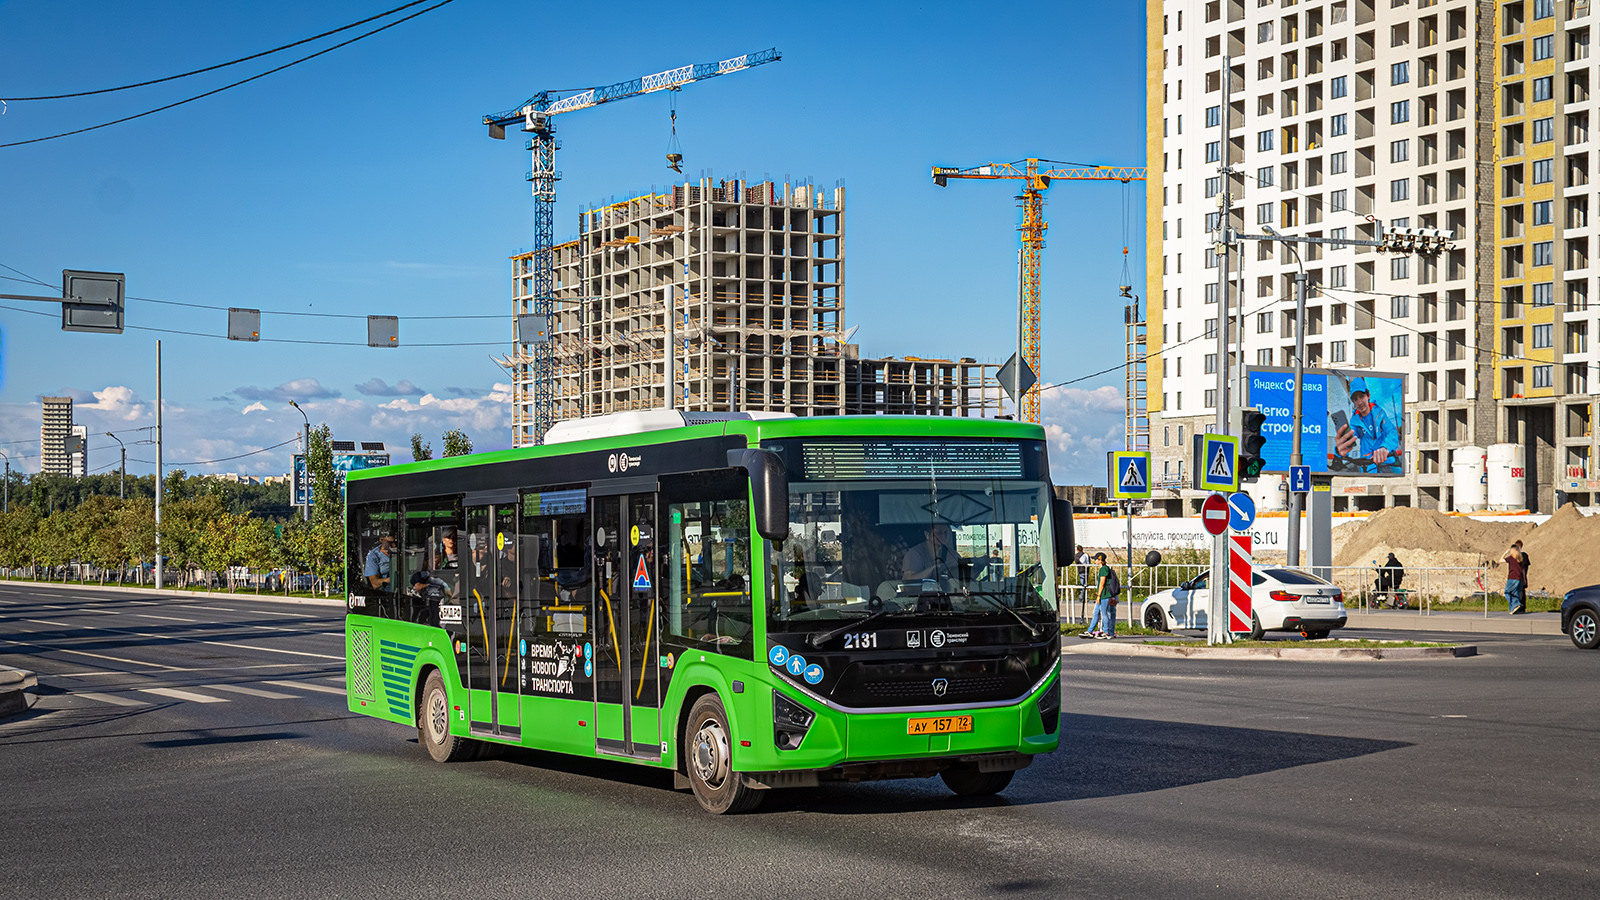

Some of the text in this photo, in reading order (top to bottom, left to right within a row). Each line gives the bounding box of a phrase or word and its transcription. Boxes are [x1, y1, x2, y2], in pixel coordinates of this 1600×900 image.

[1254, 378, 1322, 392] Яндекс авка
[1261, 422, 1321, 435] строиься
[1122, 530, 1205, 542] Пжалуйста, проходите
[843, 632, 877, 649] 2131
[531, 644, 553, 658] ВРЕМЯ
[531, 661, 557, 676] НОВОГО
[531, 677, 574, 694] ТРАНСПОРТА
[914, 717, 968, 732] АУ 157 72
